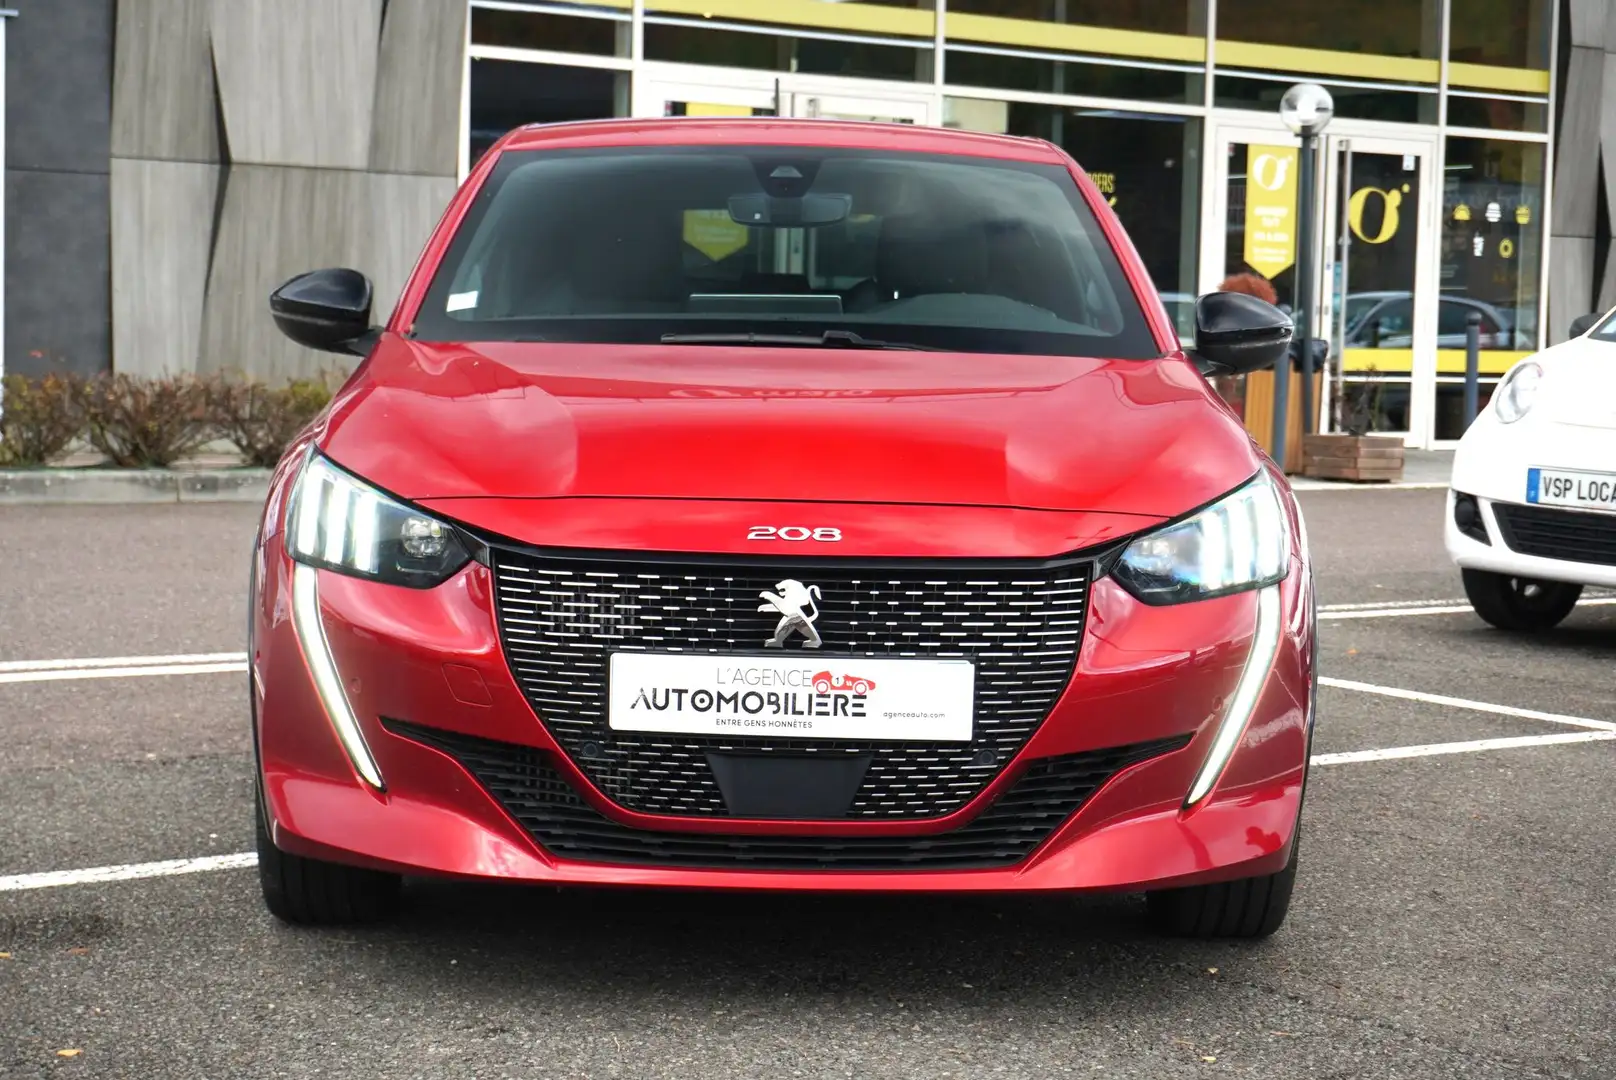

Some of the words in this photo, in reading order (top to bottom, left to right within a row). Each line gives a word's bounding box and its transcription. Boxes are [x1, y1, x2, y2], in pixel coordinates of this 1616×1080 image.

[1543, 476, 1573, 498] VSP
[746, 525, 843, 541] 208
[716, 667, 812, 687] L'AGENCE
[716, 718, 741, 727] ENTRE
[743, 719, 766, 727] GENS
[883, 710, 946, 719] agenceauto.com
